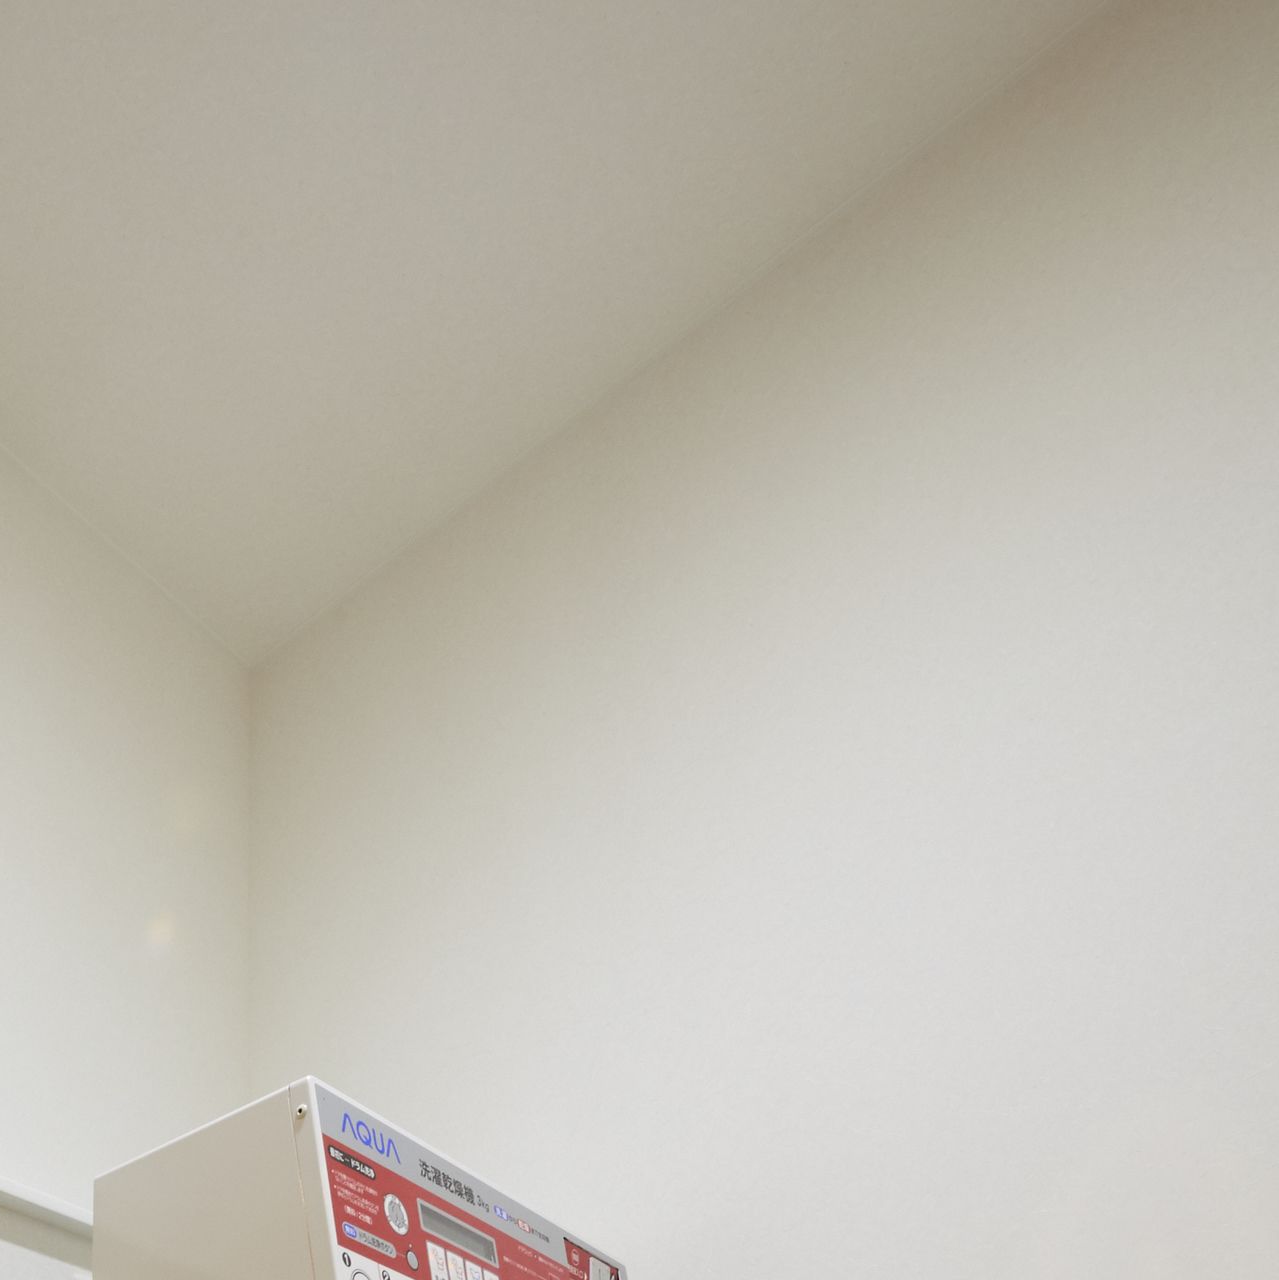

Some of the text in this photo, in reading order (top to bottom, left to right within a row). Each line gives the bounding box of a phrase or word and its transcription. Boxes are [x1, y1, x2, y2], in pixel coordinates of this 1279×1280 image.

[342, 1112, 401, 1165] AQUA
[419, 1158, 476, 1207] 洗濯乾燥機
